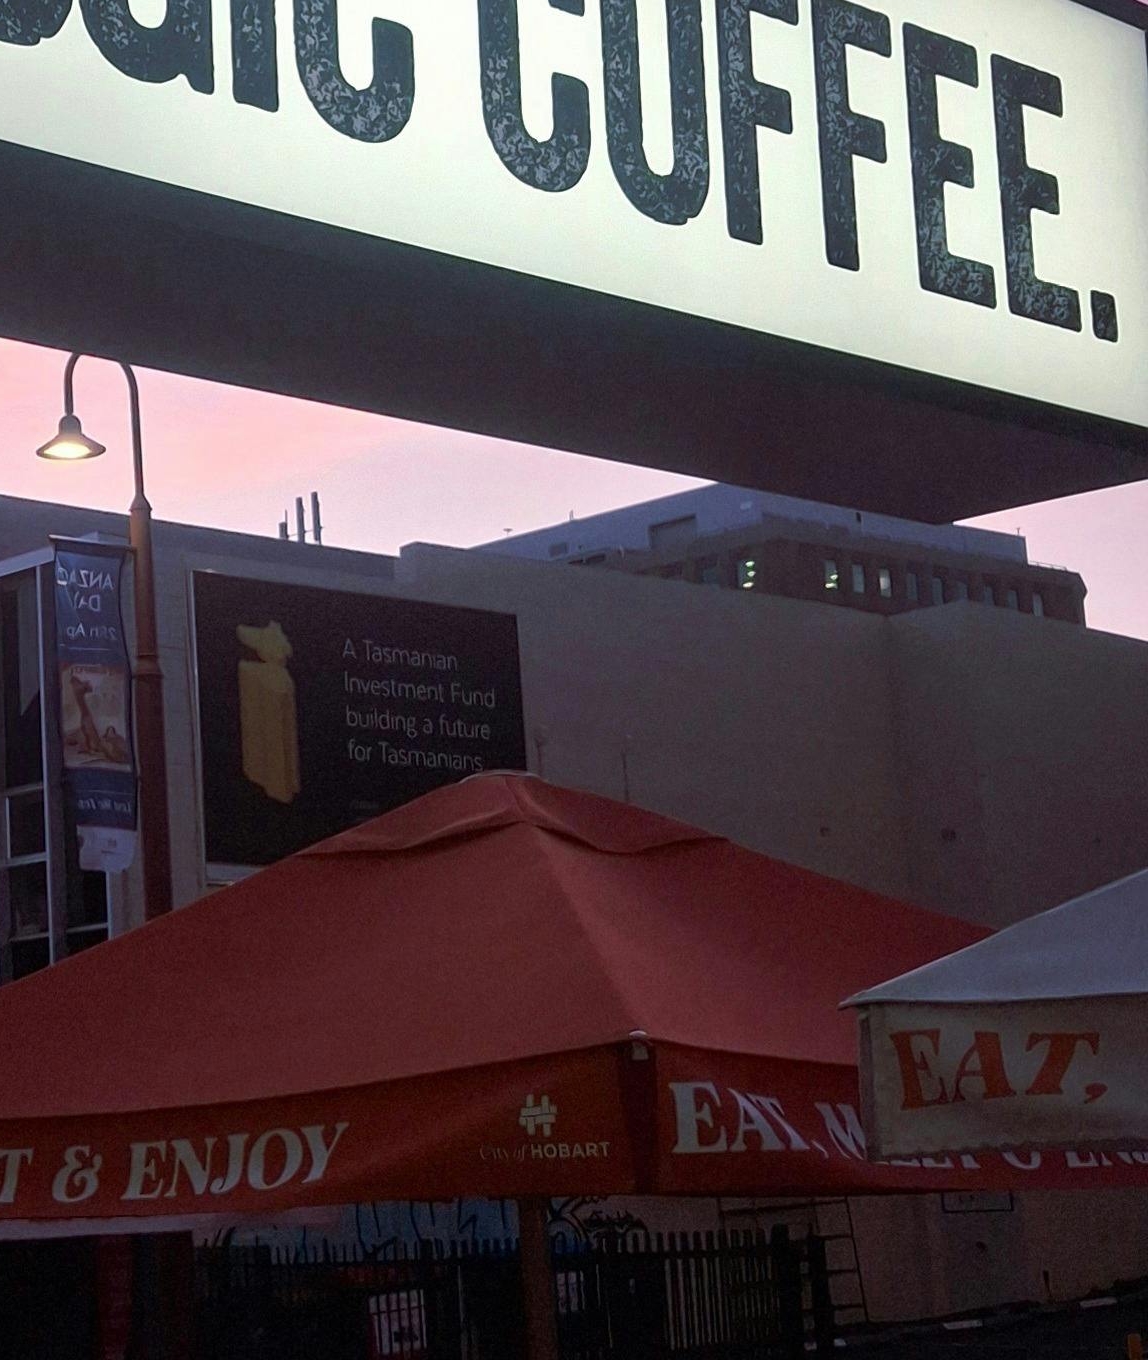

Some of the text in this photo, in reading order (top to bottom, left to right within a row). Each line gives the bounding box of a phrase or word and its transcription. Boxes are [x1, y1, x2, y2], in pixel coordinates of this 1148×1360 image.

[342, 638, 458, 671] A Tasmanian
[344, 671, 495, 708] Investment Fund
[346, 705, 492, 740] building a future
[348, 738, 484, 772] for Tasmanians
[889, 1029, 1109, 1111] EAT,
[52, 1145, 103, 1204] &
[119, 1121, 351, 1201] ENJOY
[531, 1141, 612, 1159] HOBART
